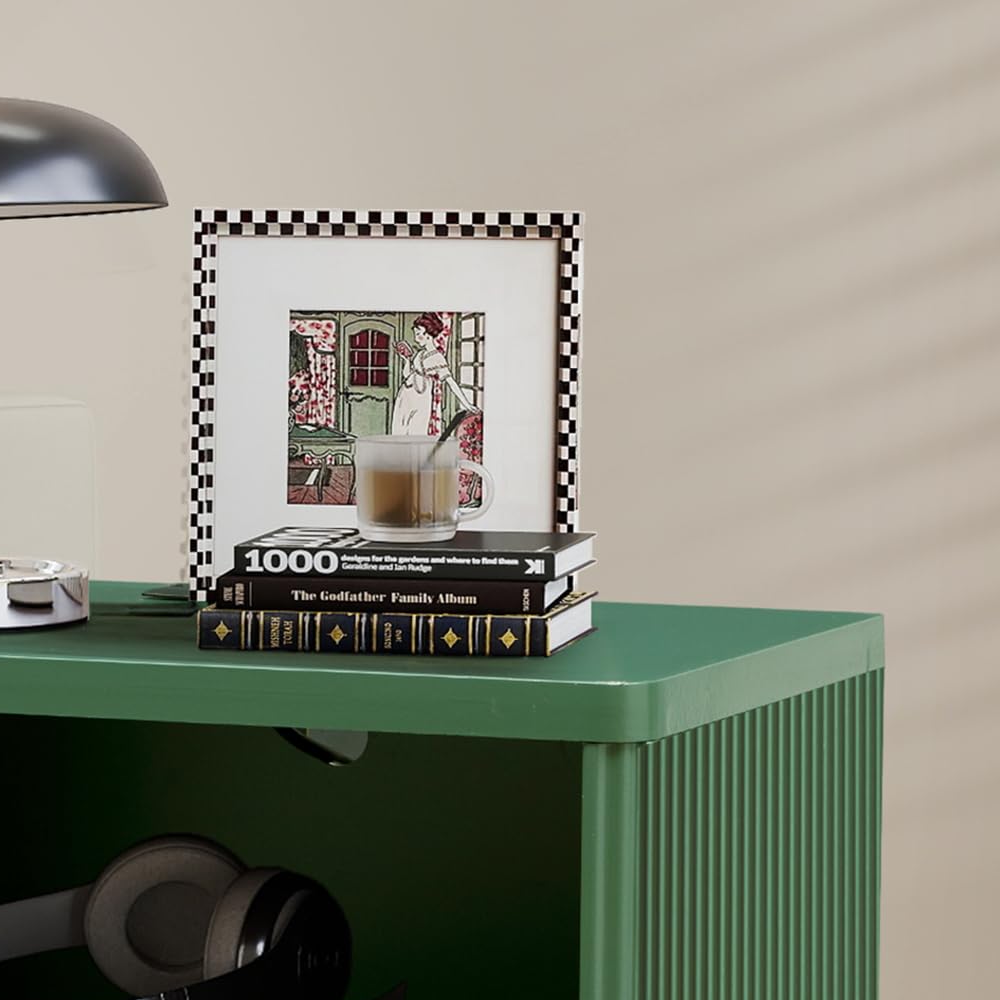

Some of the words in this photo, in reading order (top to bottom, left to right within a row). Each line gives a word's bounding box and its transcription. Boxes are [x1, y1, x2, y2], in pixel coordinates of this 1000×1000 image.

[244, 548, 339, 574] 1000
[341, 554, 371, 564] designs
[371, 554, 383, 563] for
[384, 555, 397, 563] the
[430, 556, 446, 564] and
[446, 556, 471, 565] where
[471, 557, 481, 565] to
[481, 557, 498, 565] find
[498, 557, 519, 565] them
[341, 562, 378, 571] Geraldine
[378, 563, 394, 571] and
[407, 563, 433, 574] Rudge
[290, 589, 317, 601] The
[319, 590, 387, 602] Godfather
[391, 592, 433, 607] Family
[437, 593, 477, 605] Album
